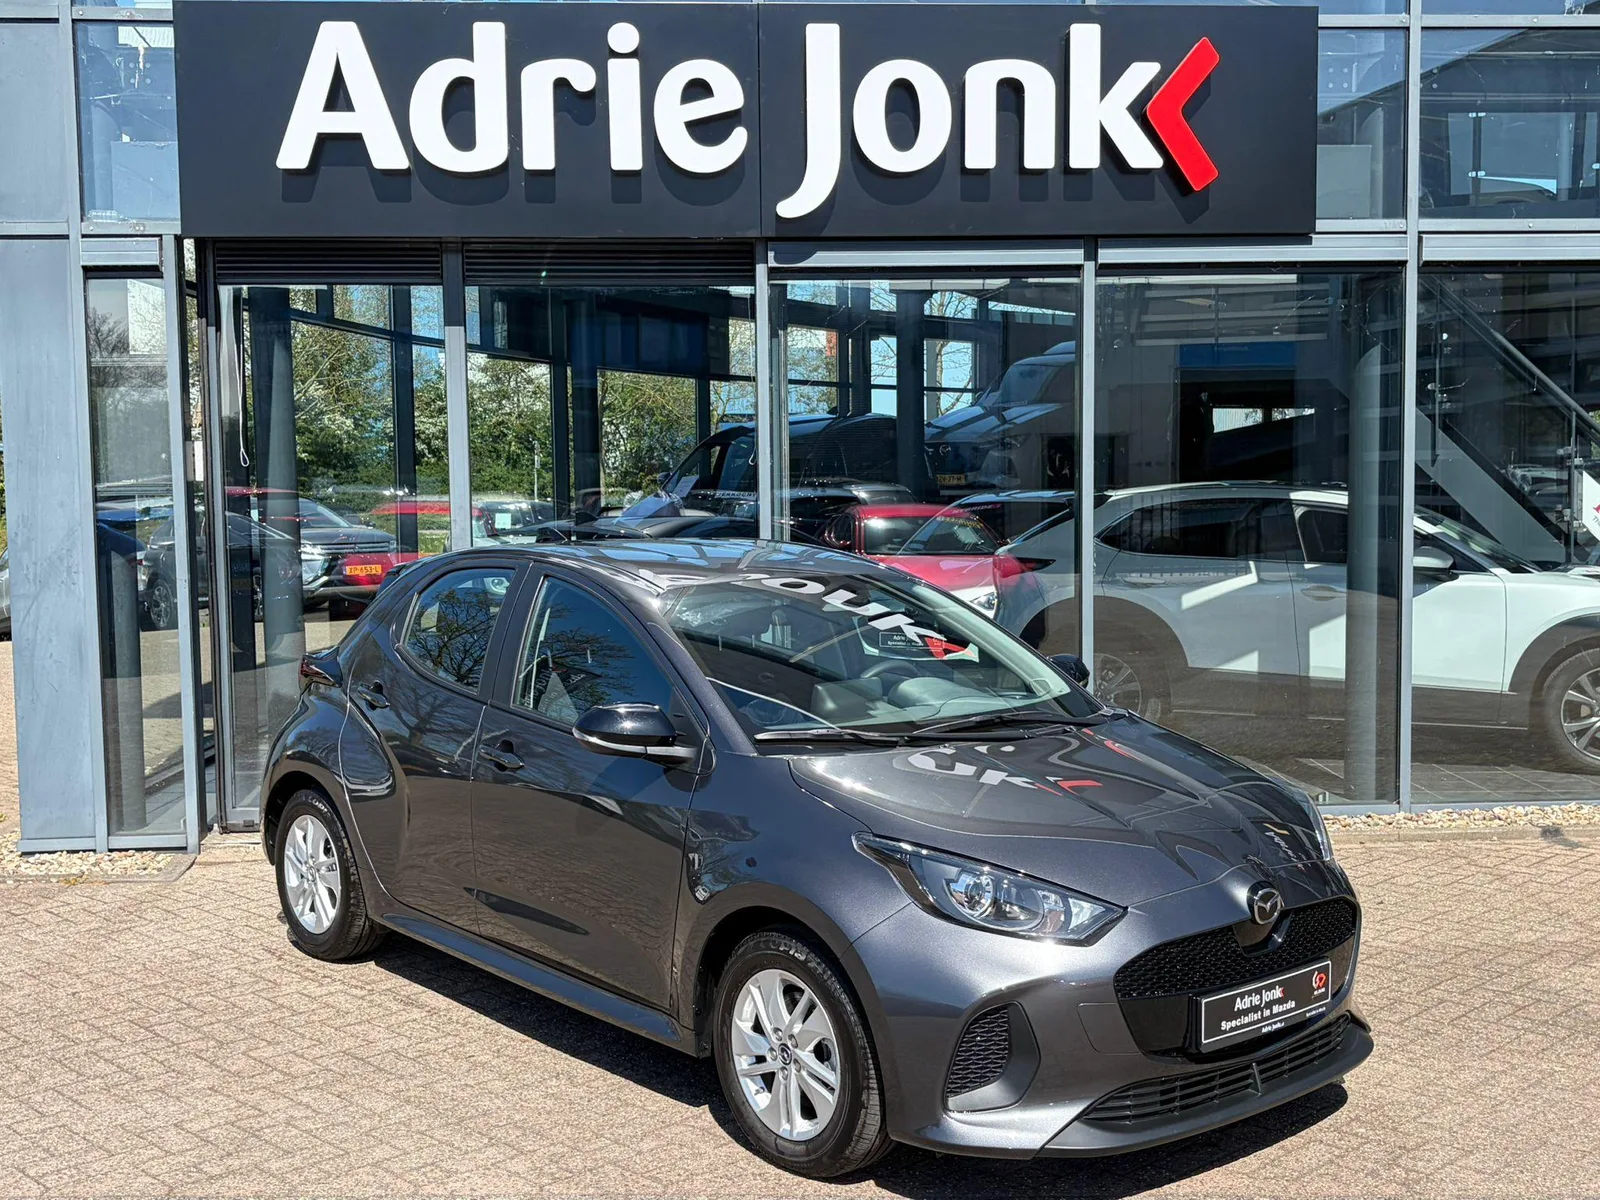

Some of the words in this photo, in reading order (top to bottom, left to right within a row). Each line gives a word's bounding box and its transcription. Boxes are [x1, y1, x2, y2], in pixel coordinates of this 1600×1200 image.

[276, 21, 749, 173] Adrie
[776, 22, 1166, 219] Jonk
[1234, 989, 1260, 1011] Adrie
[1260, 985, 1283, 1007] Jonk
[1220, 1009, 1262, 1031] Specialist
[1263, 1007, 1271, 1017] in
[1272, 999, 1296, 1015] Mazda
